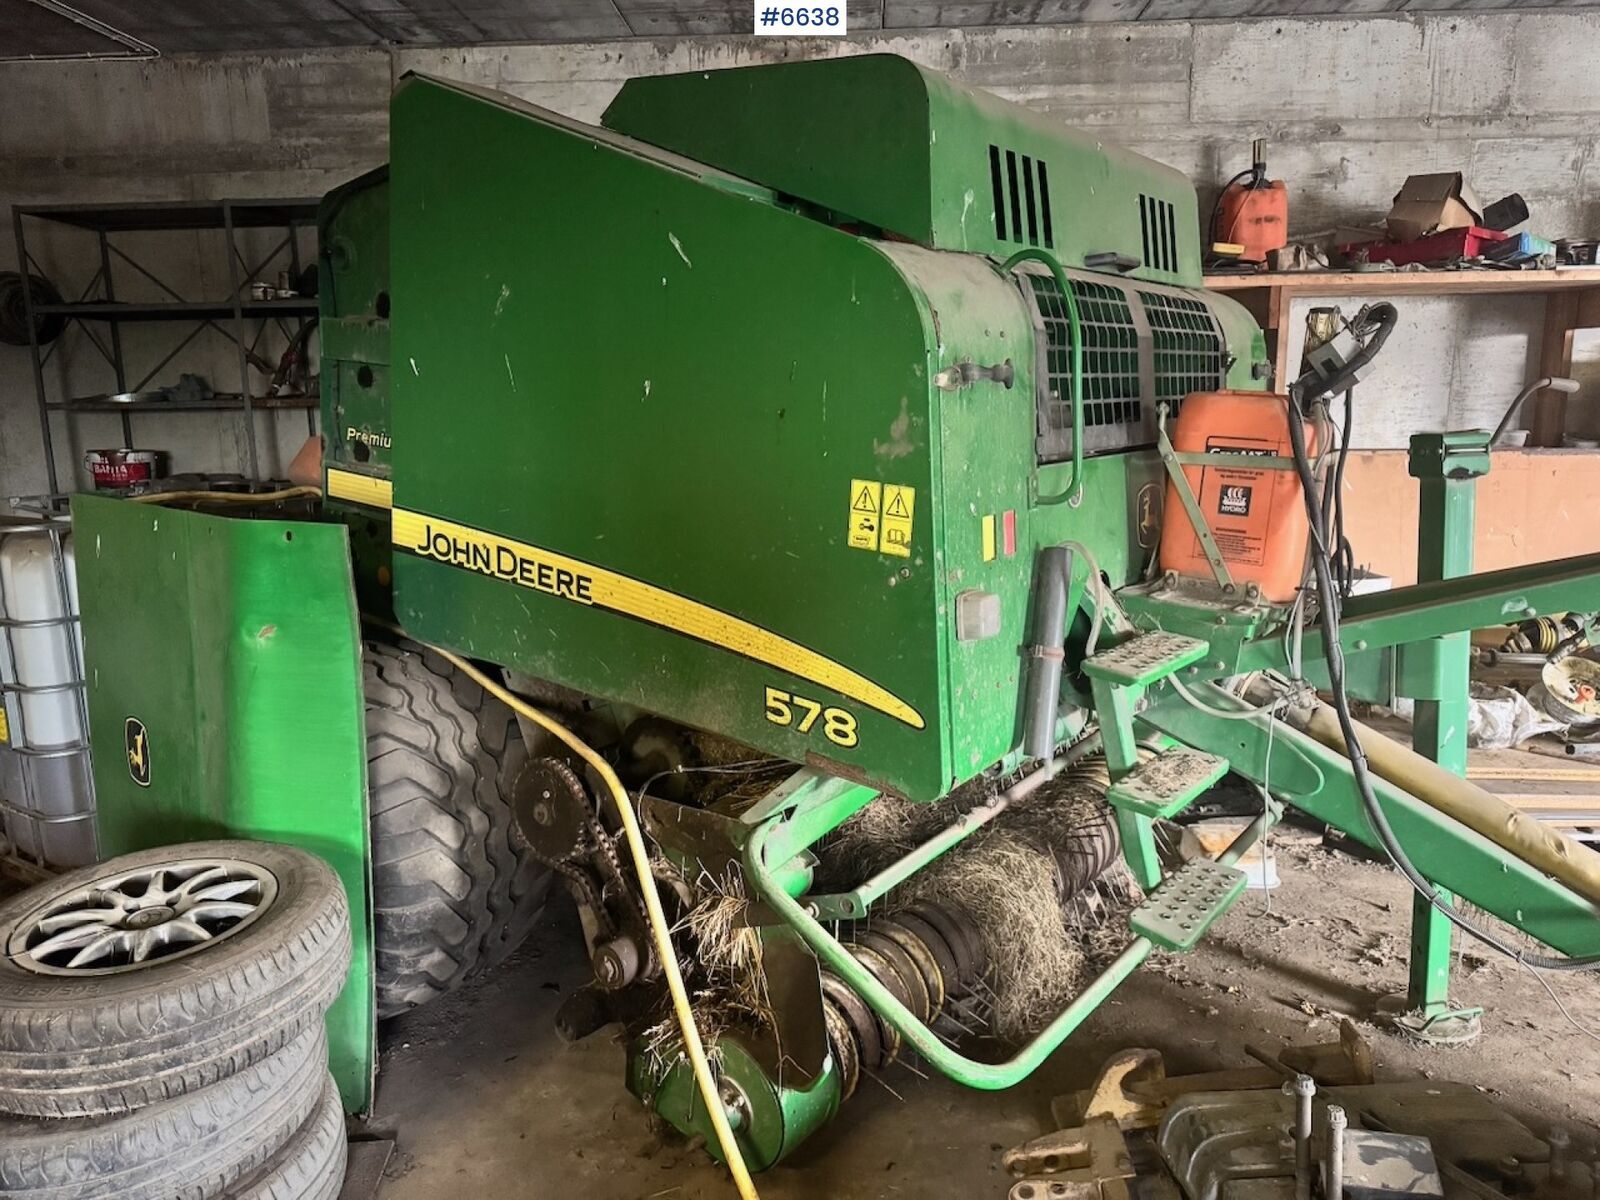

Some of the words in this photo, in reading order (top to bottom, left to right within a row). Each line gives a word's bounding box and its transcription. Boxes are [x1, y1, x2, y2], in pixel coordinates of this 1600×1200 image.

[418, 525, 490, 570] JOHN
[496, 545, 592, 601] DEERE
[765, 686, 858, 748] 578
